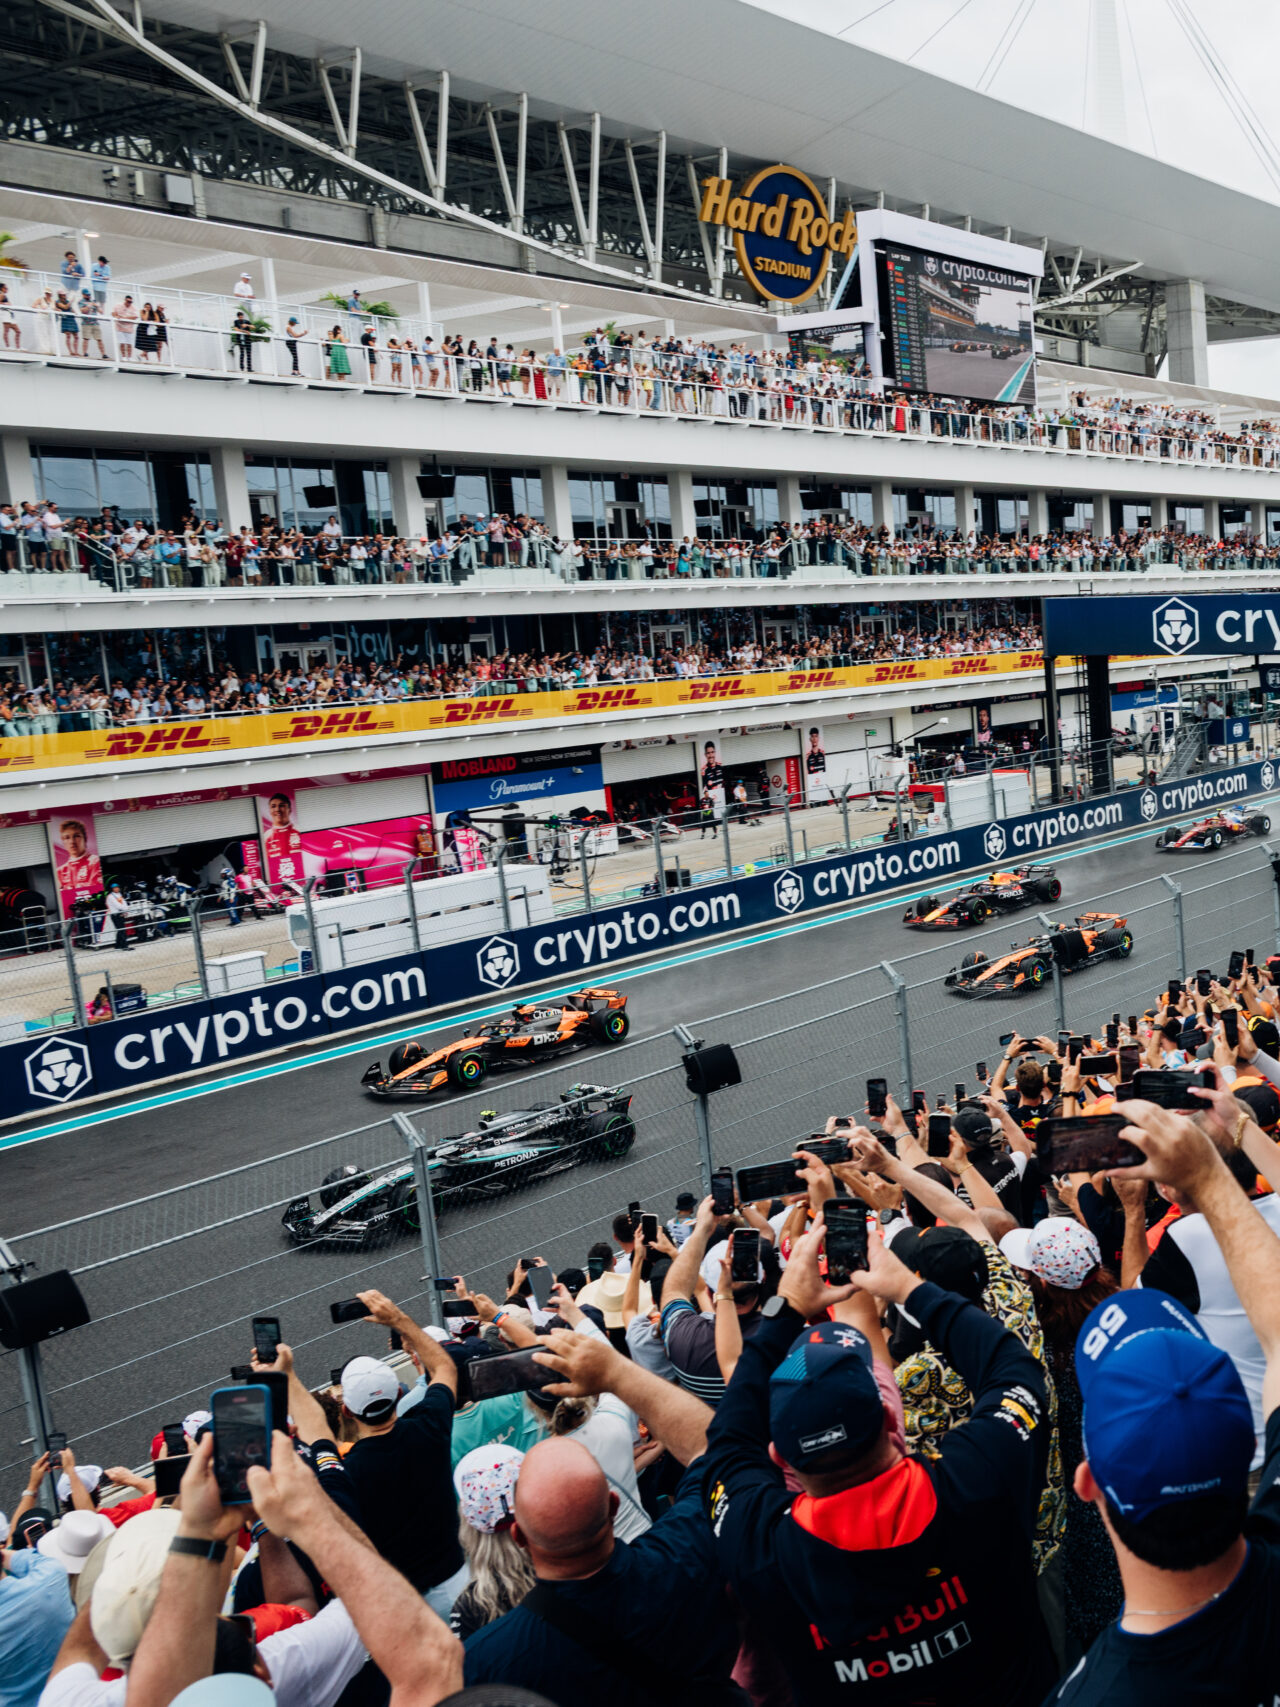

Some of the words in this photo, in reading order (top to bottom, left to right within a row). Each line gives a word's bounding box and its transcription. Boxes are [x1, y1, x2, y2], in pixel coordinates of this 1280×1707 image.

[699, 176, 789, 238] Hard
[786, 198, 859, 260] Rock
[753, 256, 812, 281] STADIUM
[941, 261, 1016, 286] crypto.com
[951, 657, 991, 675] DHL
[1019, 651, 1045, 668] DH
[787, 671, 837, 691] DHL
[874, 664, 917, 683] DHL
[575, 688, 641, 711] DHL
[689, 679, 746, 701] DHL
[444, 698, 520, 723] DHL
[289, 710, 378, 738] DHL
[106, 726, 211, 757] DHL
[488, 776, 555, 801] Paramount+
[1162, 773, 1248, 811] crypto.com
[1012, 802, 1123, 848] crypto.com
[813, 840, 961, 897] crypto.com
[533, 891, 741, 967] crypto.com
[113, 966, 429, 1071] crypto.com
[533, 1031, 560, 1046] OKX
[494, 1147, 539, 1169] PETRONAS
[288, 1200, 309, 1214] INEOS
[894, 1575, 968, 1635] Bull
[834, 1640, 934, 1683] Mobil
[943, 1630, 960, 1650] 1
